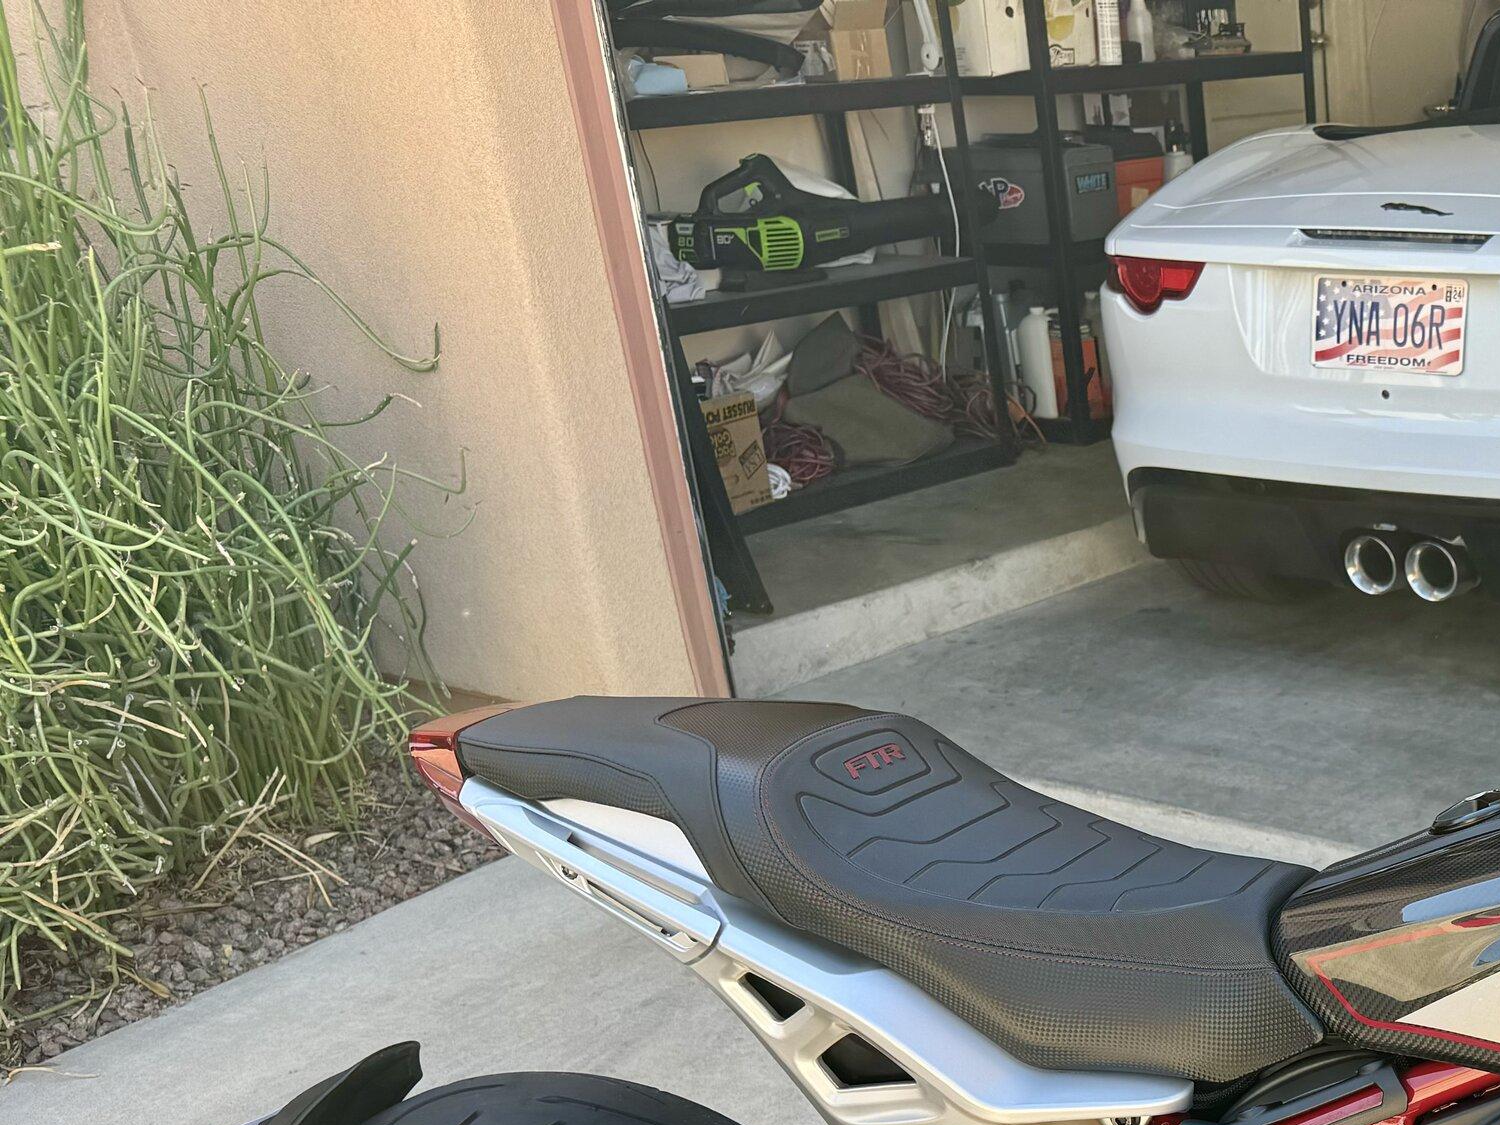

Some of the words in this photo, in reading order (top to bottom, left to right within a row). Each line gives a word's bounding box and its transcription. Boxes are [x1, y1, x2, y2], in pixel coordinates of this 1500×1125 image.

[1352, 284, 1426, 296] ARIZONA
[1333, 300, 1381, 346] YNA
[1346, 354, 1425, 367] FREEDOM
[723, 399, 757, 420] RUSSET
[843, 743, 906, 780] FTR
